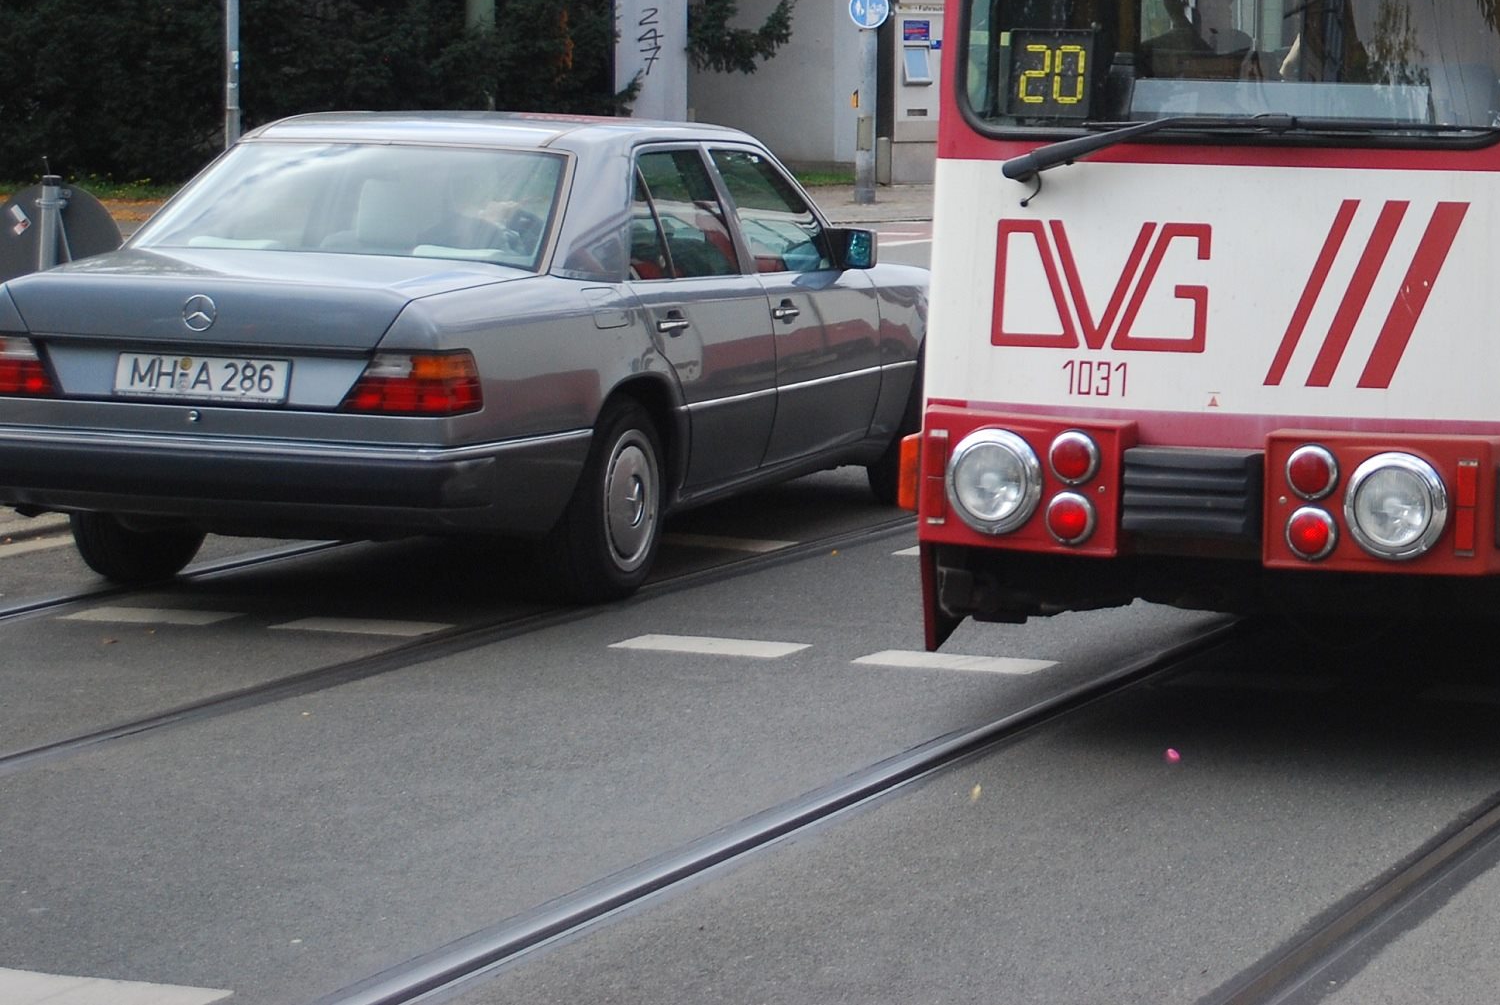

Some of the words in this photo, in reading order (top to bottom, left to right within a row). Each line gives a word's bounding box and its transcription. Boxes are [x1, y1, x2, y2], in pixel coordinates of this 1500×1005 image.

[1019, 44, 1086, 104] 20
[990, 218, 1213, 353] DVG
[130, 357, 178, 389] MH
[191, 360, 213, 391] A
[221, 362, 276, 394] 286
[1061, 359, 1128, 398] 1031
